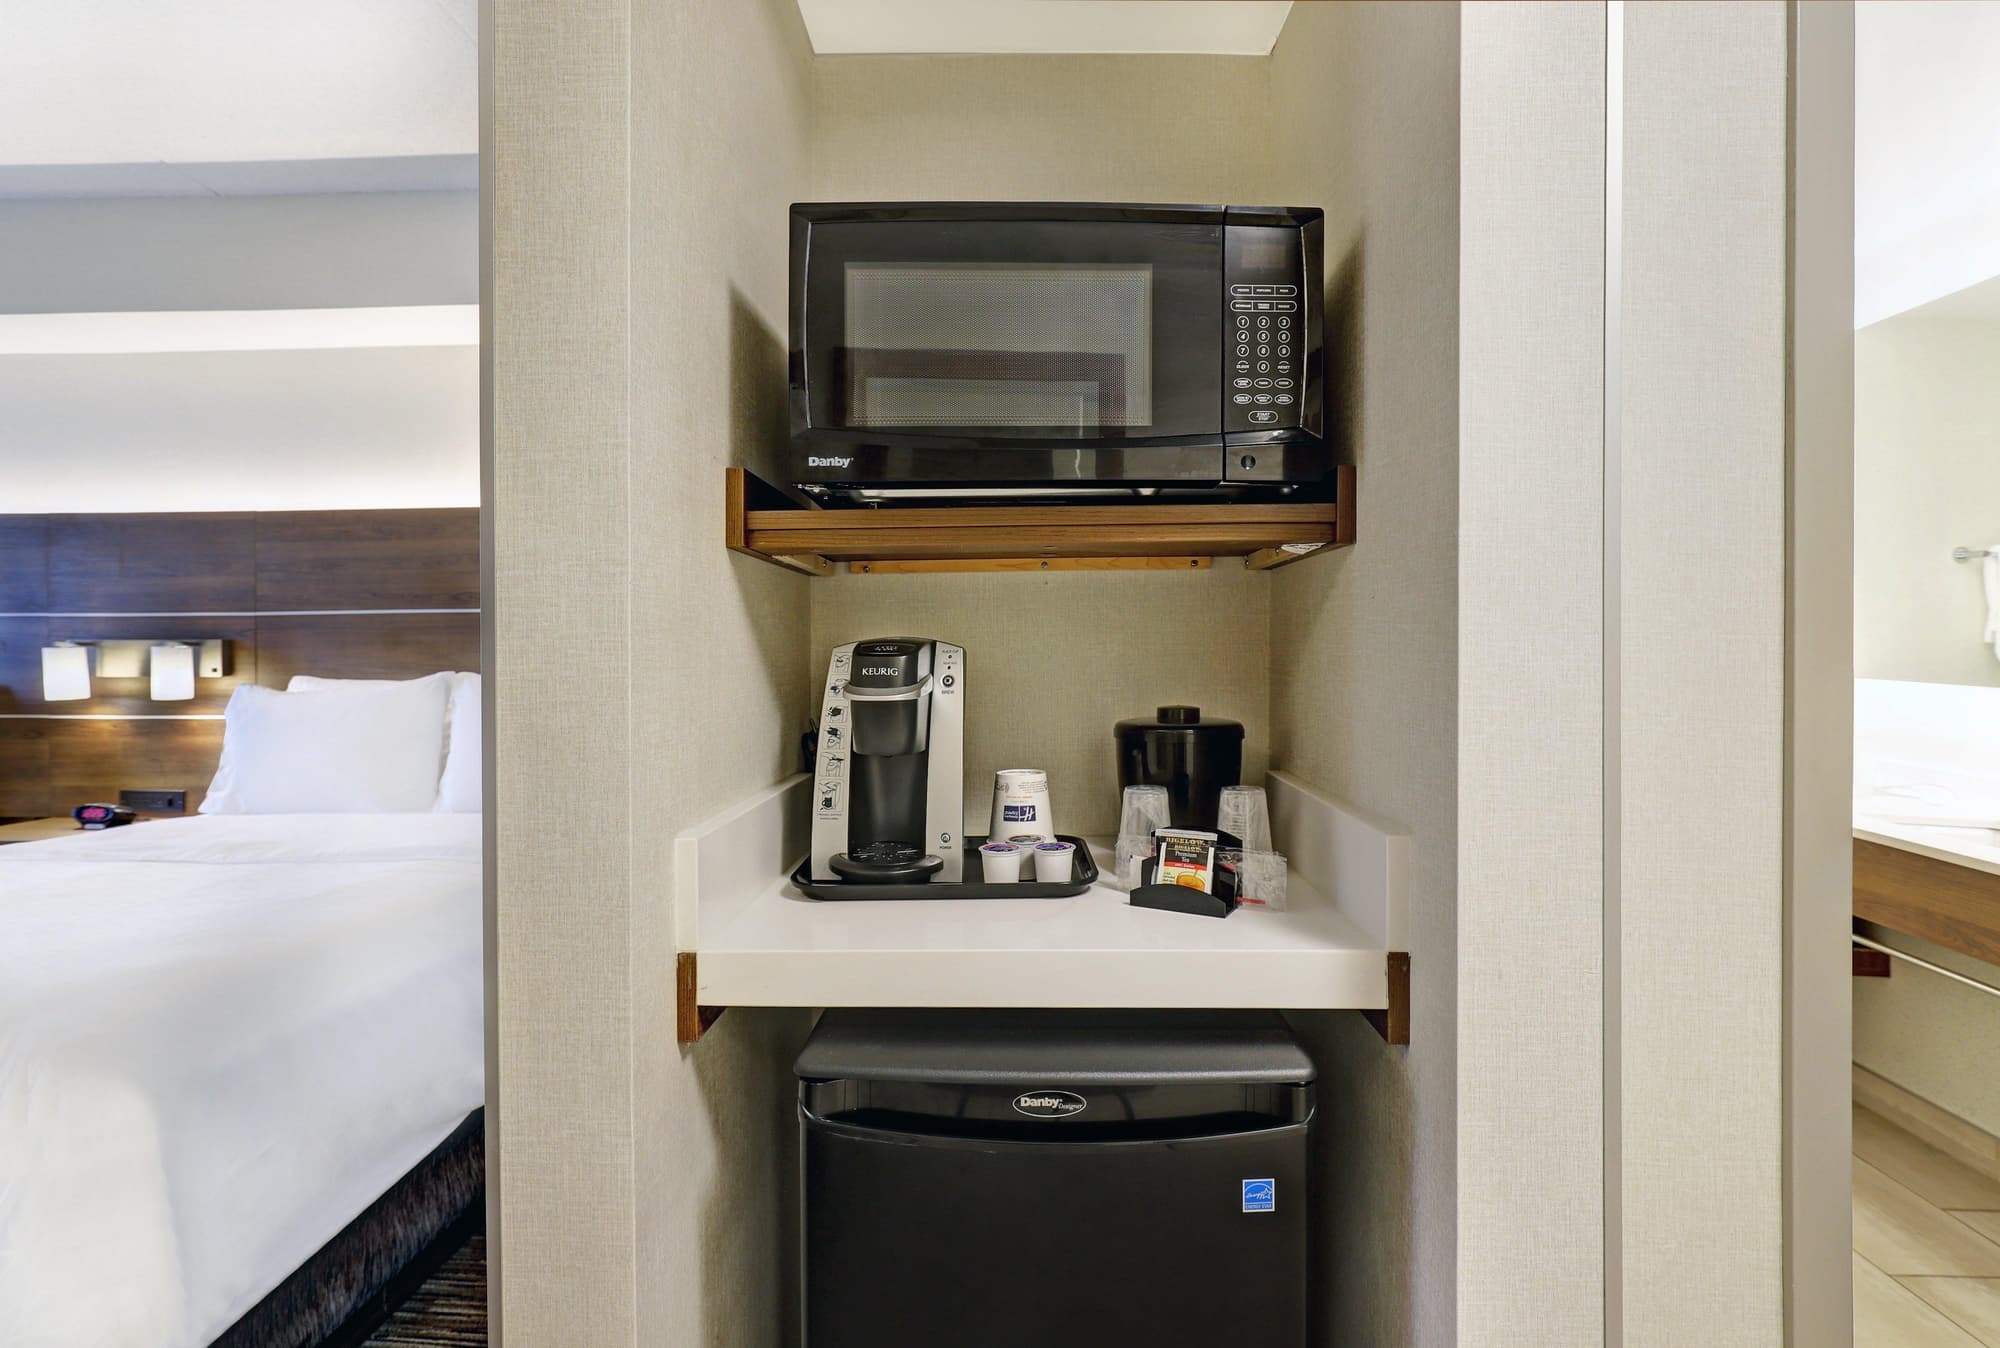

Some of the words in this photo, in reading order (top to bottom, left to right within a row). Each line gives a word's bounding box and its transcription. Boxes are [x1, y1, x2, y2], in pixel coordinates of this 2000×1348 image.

[808, 456, 851, 468] Danby
[862, 667, 898, 676] KEURIG
[1020, 1097, 1060, 1109] Danby
